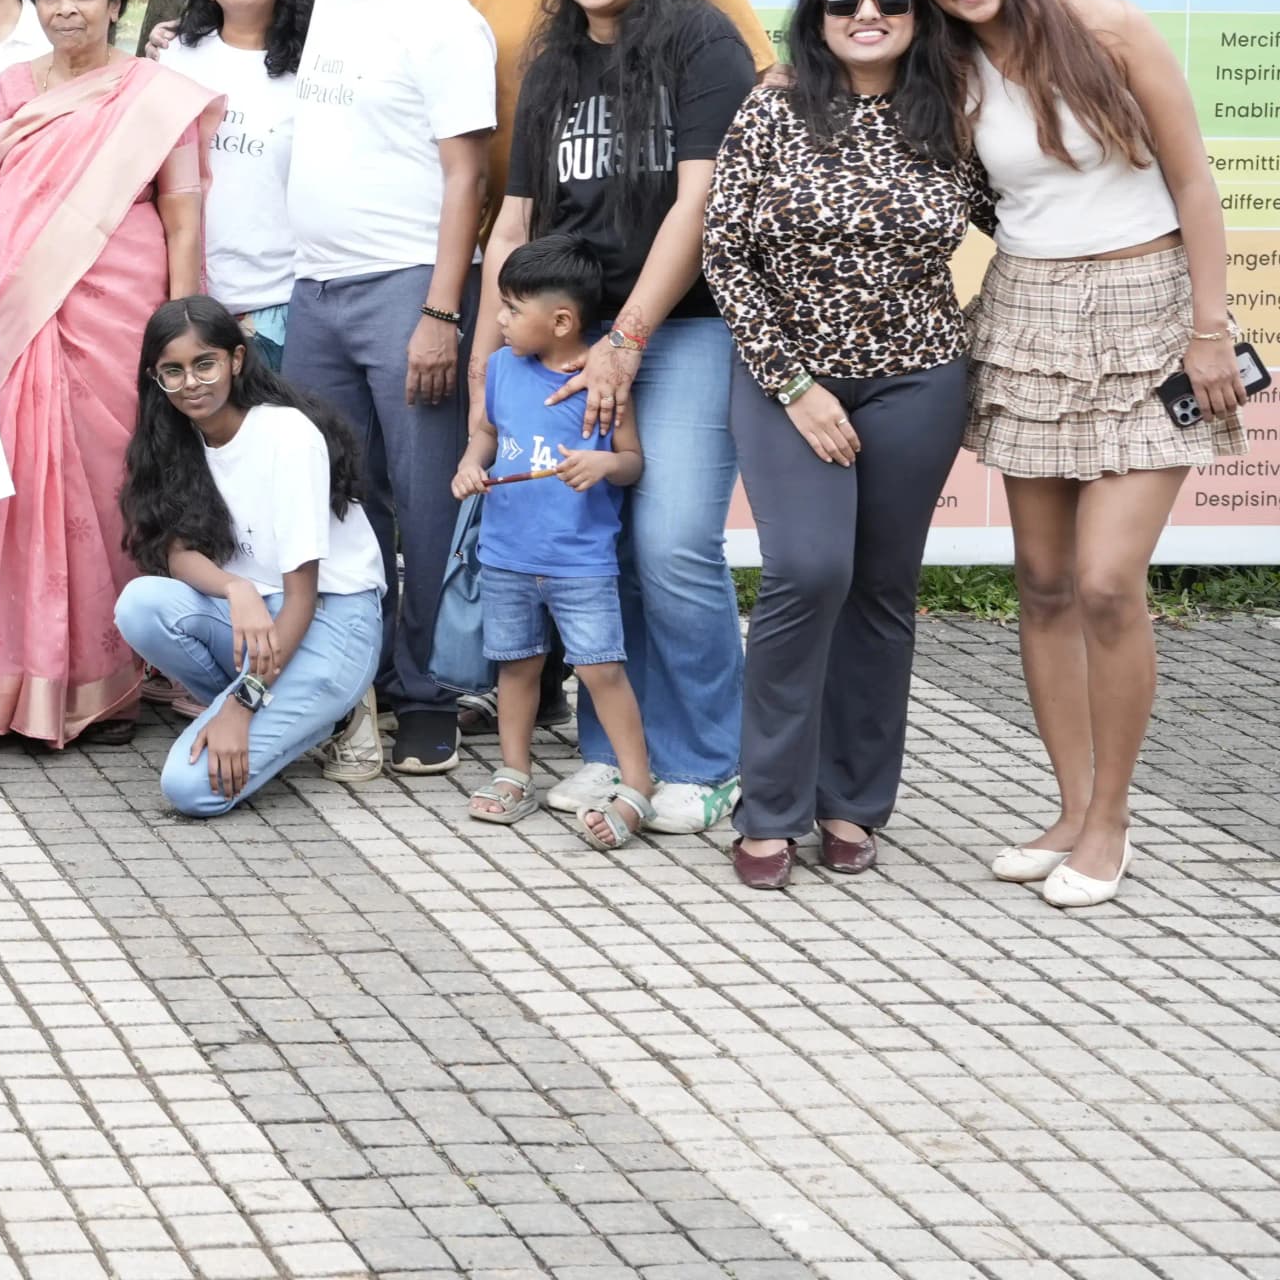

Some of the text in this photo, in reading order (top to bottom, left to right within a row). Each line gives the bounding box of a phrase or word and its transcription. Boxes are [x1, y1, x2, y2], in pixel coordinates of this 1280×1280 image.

[1216, 65, 1280, 85] Inspiri
[209, 132, 264, 157] acle
[1221, 193, 1280, 210] differe
[1195, 491, 1280, 511] Despisin
